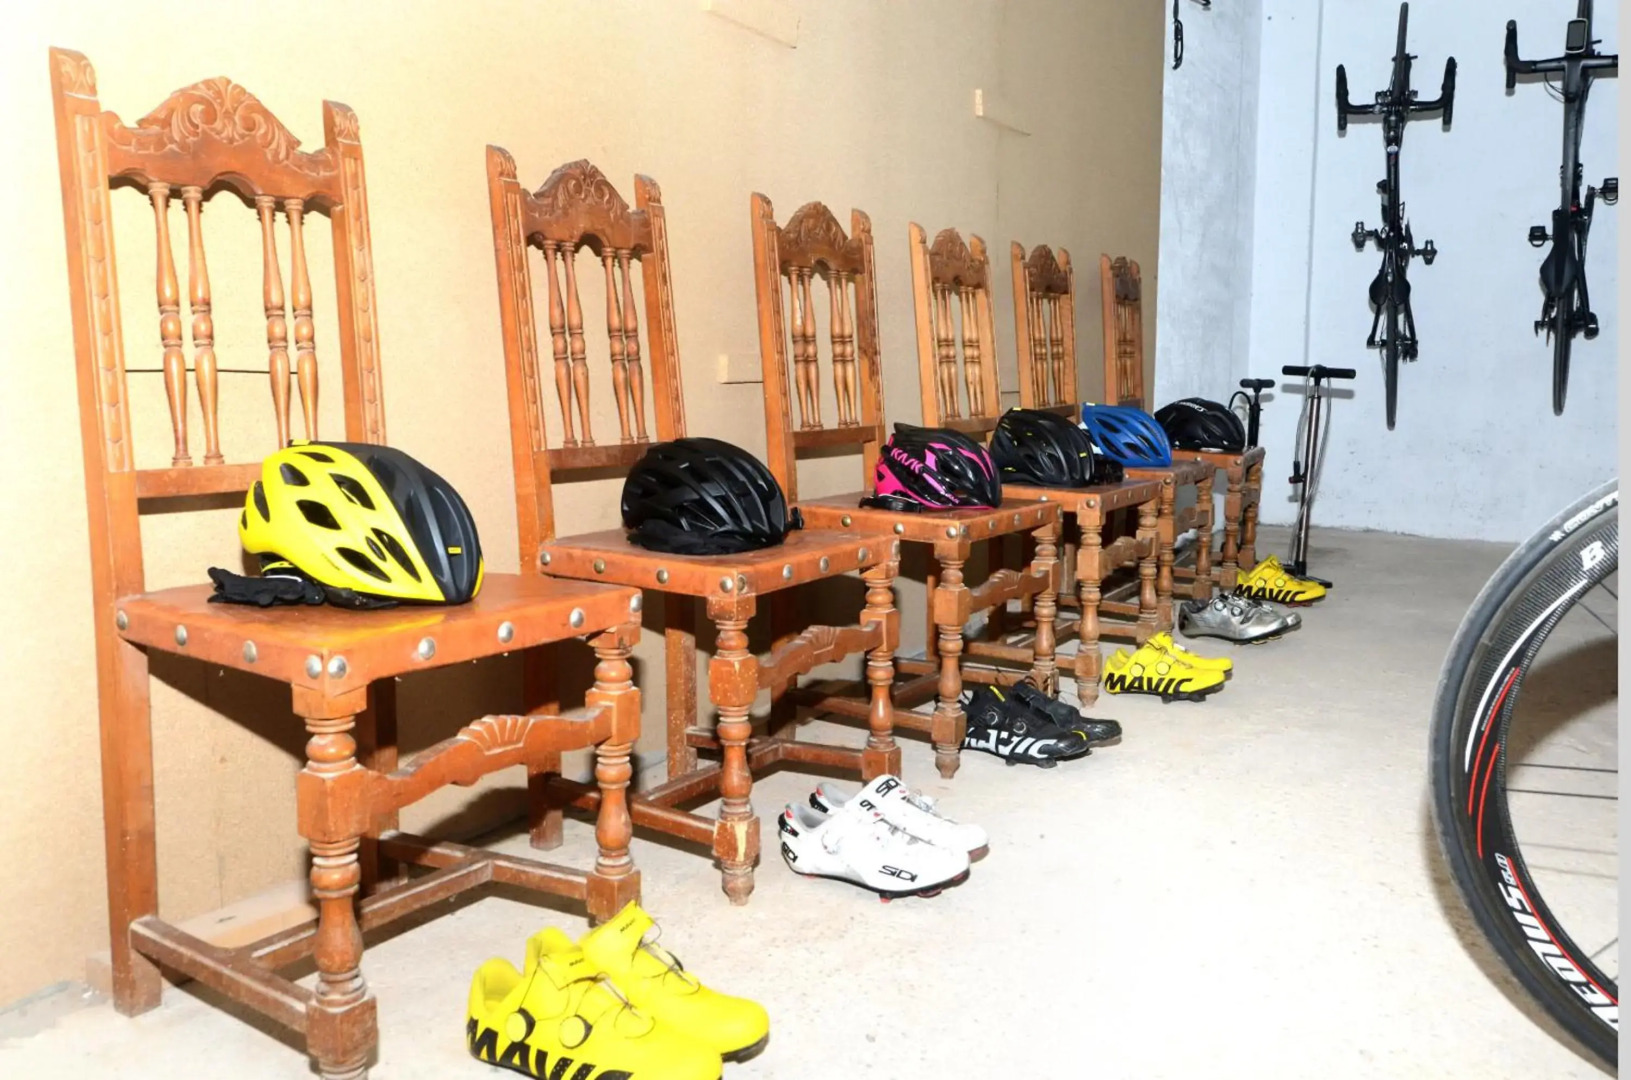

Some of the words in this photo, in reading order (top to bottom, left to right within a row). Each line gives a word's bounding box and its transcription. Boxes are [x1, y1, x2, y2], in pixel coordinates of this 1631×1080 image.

[1232, 583, 1306, 603] MAVIC
[1105, 672, 1194, 694] MAVIC
[878, 864, 918, 882] SIDI
[467, 1016, 634, 1080] MAV
